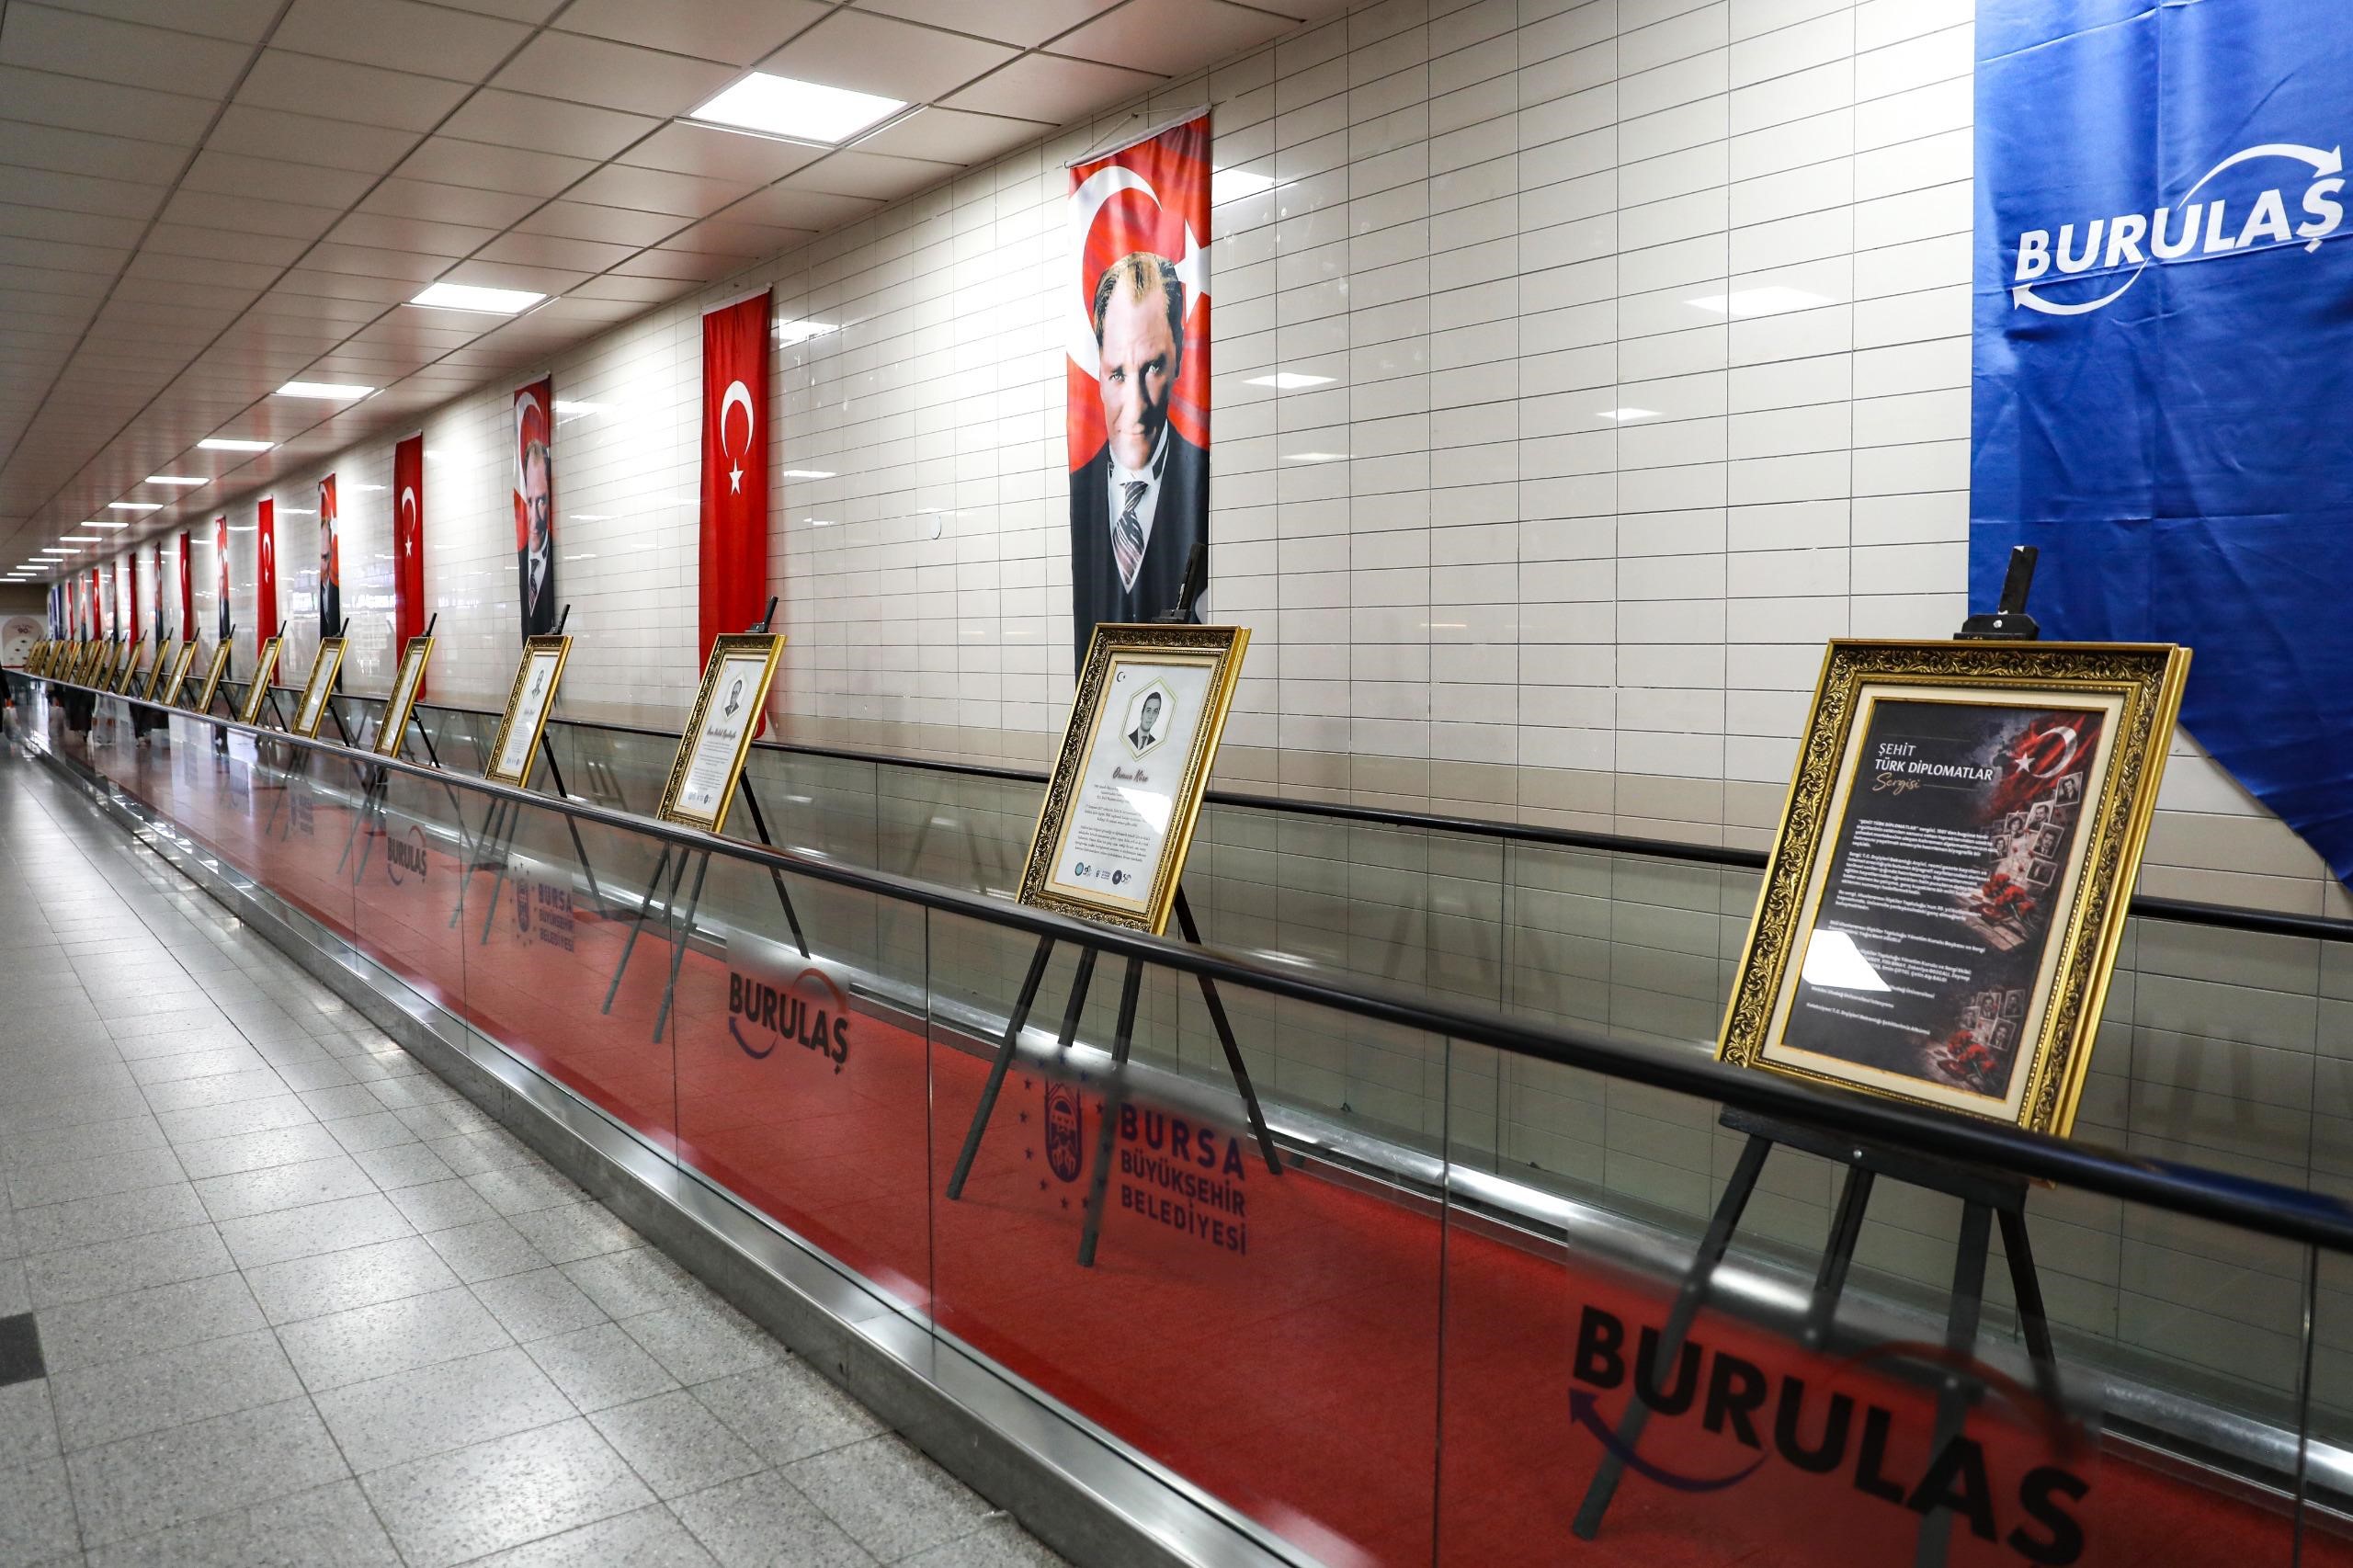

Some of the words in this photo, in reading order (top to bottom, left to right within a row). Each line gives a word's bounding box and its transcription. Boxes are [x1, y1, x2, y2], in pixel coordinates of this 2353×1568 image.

[2015, 177, 2346, 281] BURULAŞ
[1875, 757, 1906, 773] TÜRK
[1907, 759, 1994, 781] DİPLOMATLAR
[1878, 743, 1916, 756] ŞEHİT
[1871, 772, 1920, 796] Sergisi
[387, 837, 427, 883] BURULAŞ
[729, 971, 848, 1074] BURULAŞ
[1120, 1102, 1245, 1181] BURSA
[1121, 1184, 1246, 1256] BELEDİYESİ
